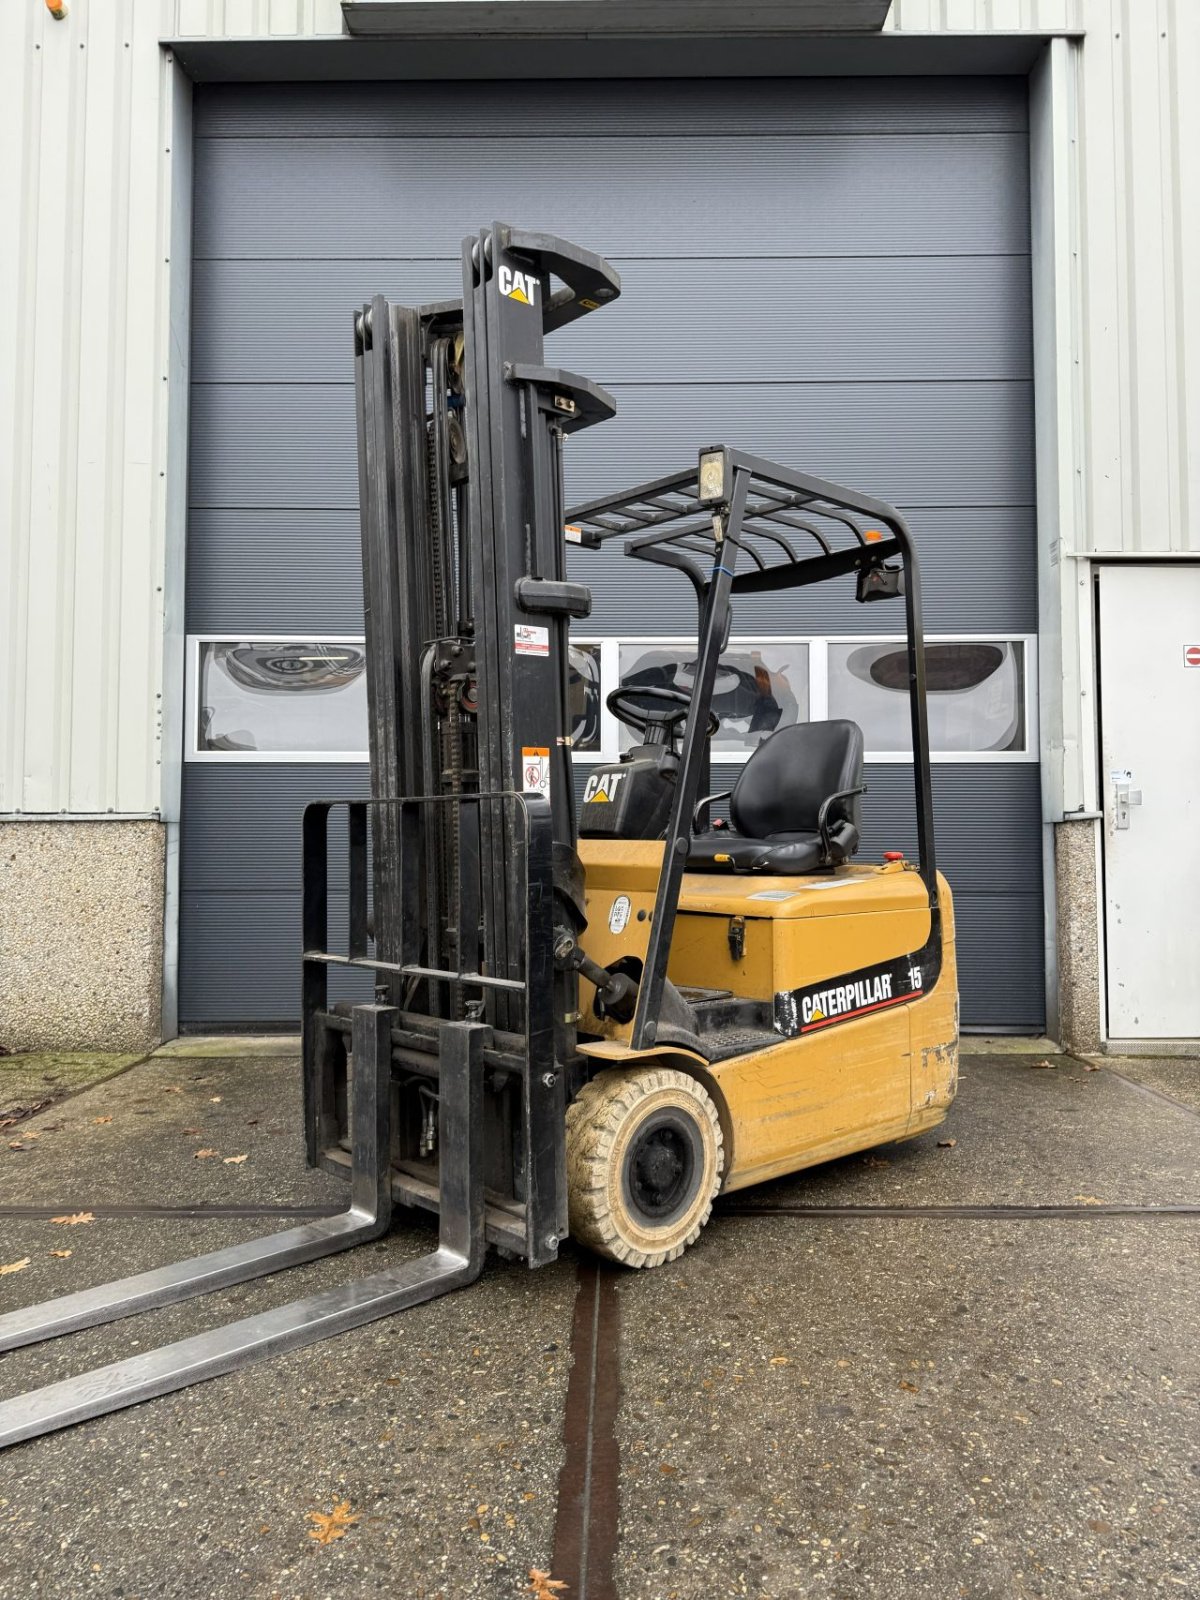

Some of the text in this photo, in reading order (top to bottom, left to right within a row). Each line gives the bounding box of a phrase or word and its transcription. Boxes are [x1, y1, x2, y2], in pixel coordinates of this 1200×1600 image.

[498, 264, 538, 306] CAT
[583, 772, 624, 803] CAT
[802, 966, 923, 1024] CATERPILLAR 15
